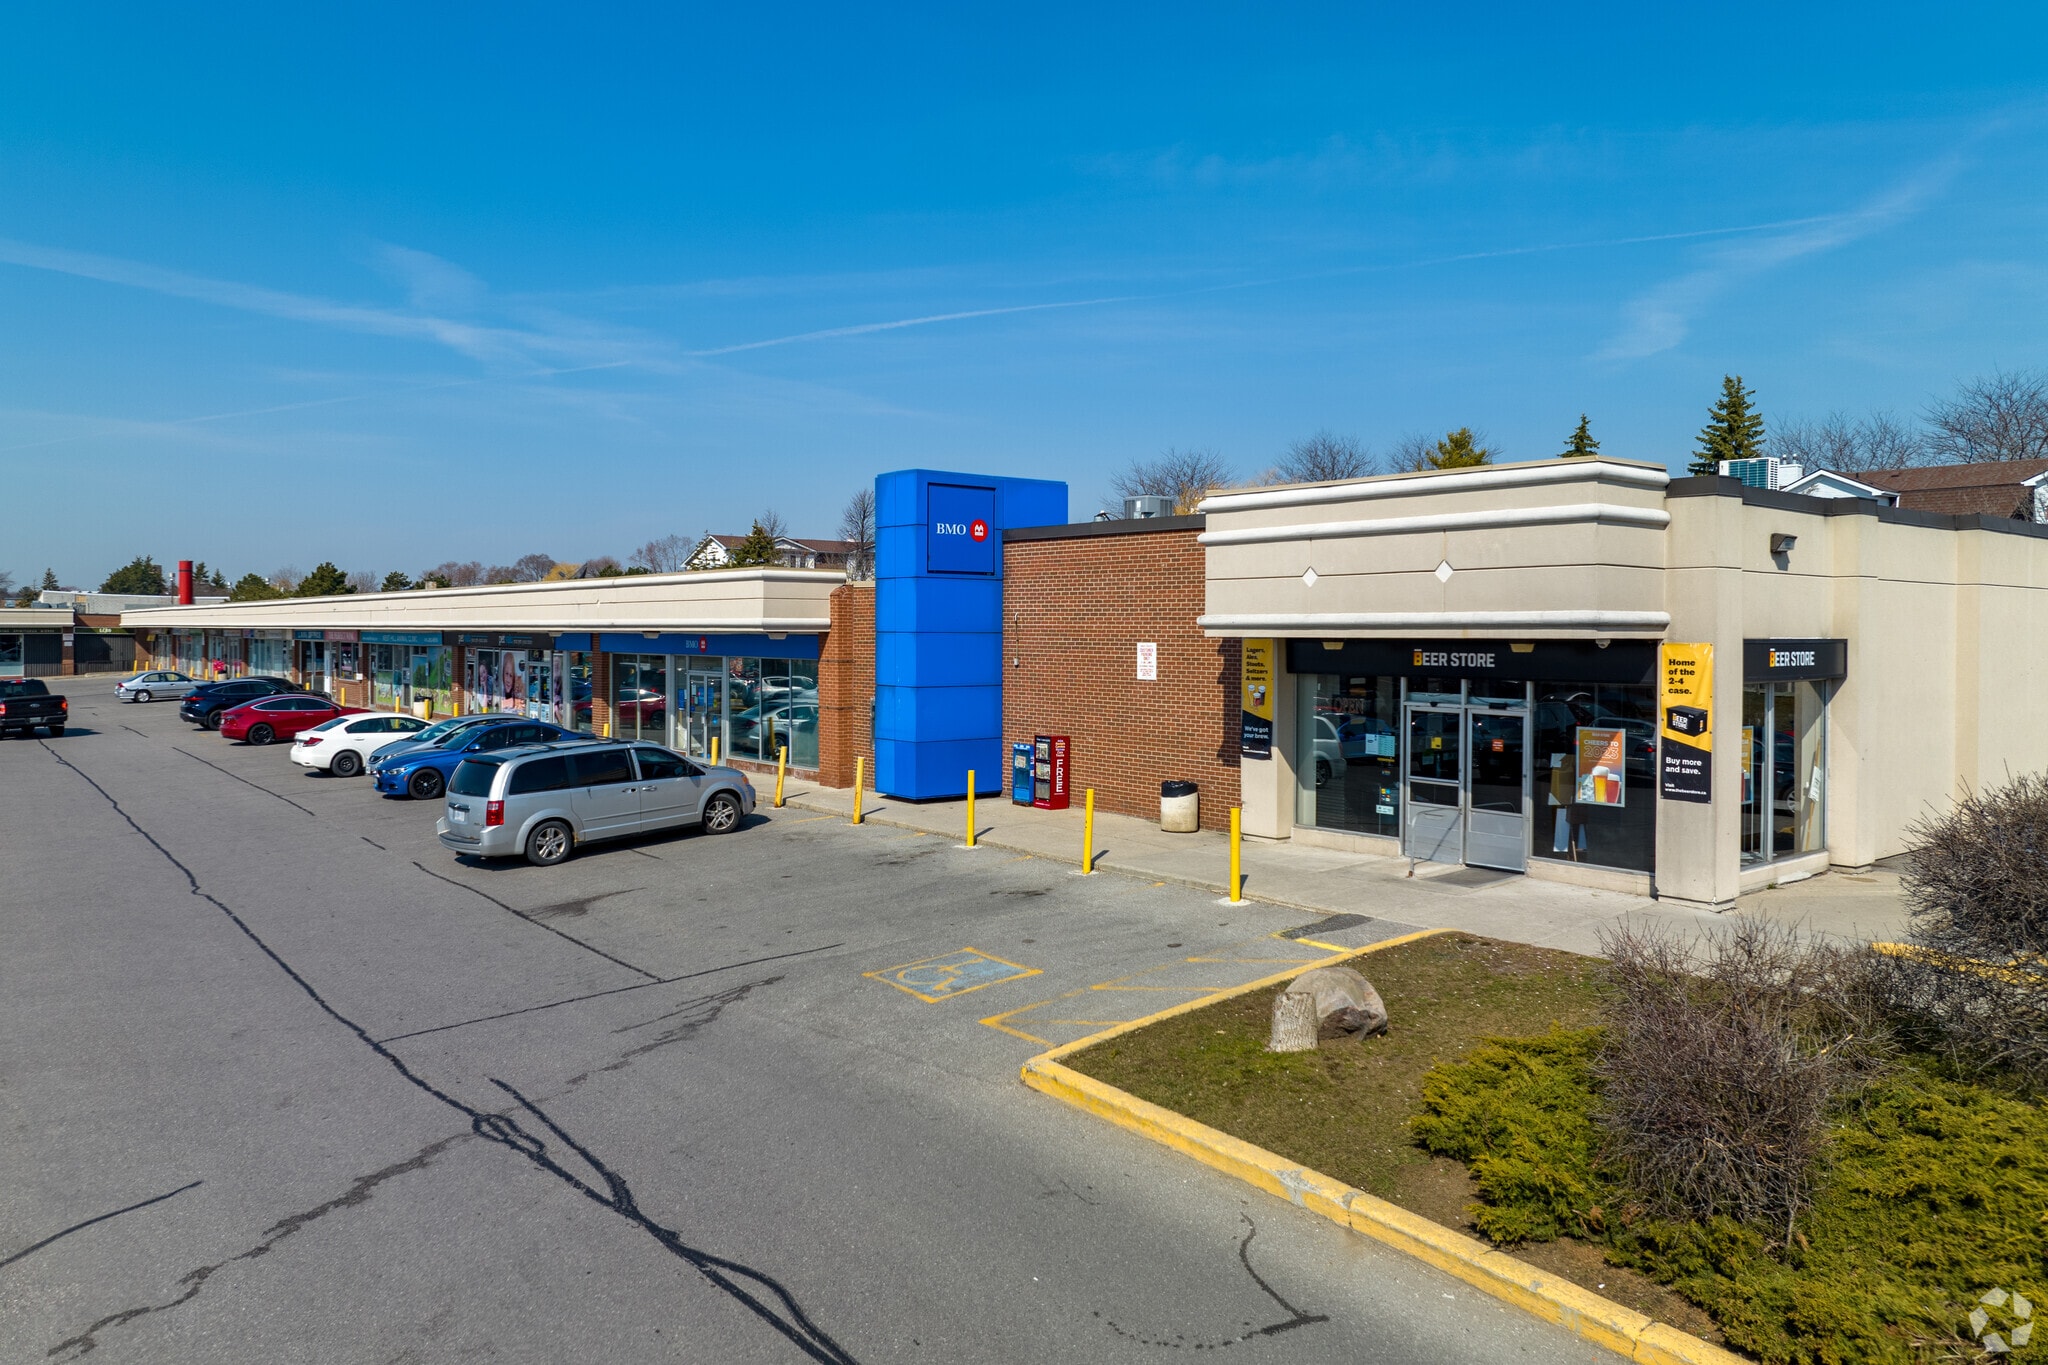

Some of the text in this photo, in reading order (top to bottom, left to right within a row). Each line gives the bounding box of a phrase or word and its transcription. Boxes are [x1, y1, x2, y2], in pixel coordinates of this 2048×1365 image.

[936, 522, 967, 536] BMO
[685, 639, 699, 649] BMO
[1413, 649, 1496, 668] BEER STORE
[1668, 658, 1696, 667] Home
[1769, 648, 1815, 667] BEER STORE
[1668, 667, 1696, 676] of the
[1668, 677, 1685, 685] 2-4
[1668, 687, 1693, 695] case.
[1672, 712, 1688, 723] BEER
[1584, 739, 1609, 747] CHEERS
[1584, 746, 1619, 760] 2023
[1665, 756, 1703, 767] Buy more
[1055, 758, 1064, 793] FREE
[1681, 767, 1702, 775] save.
